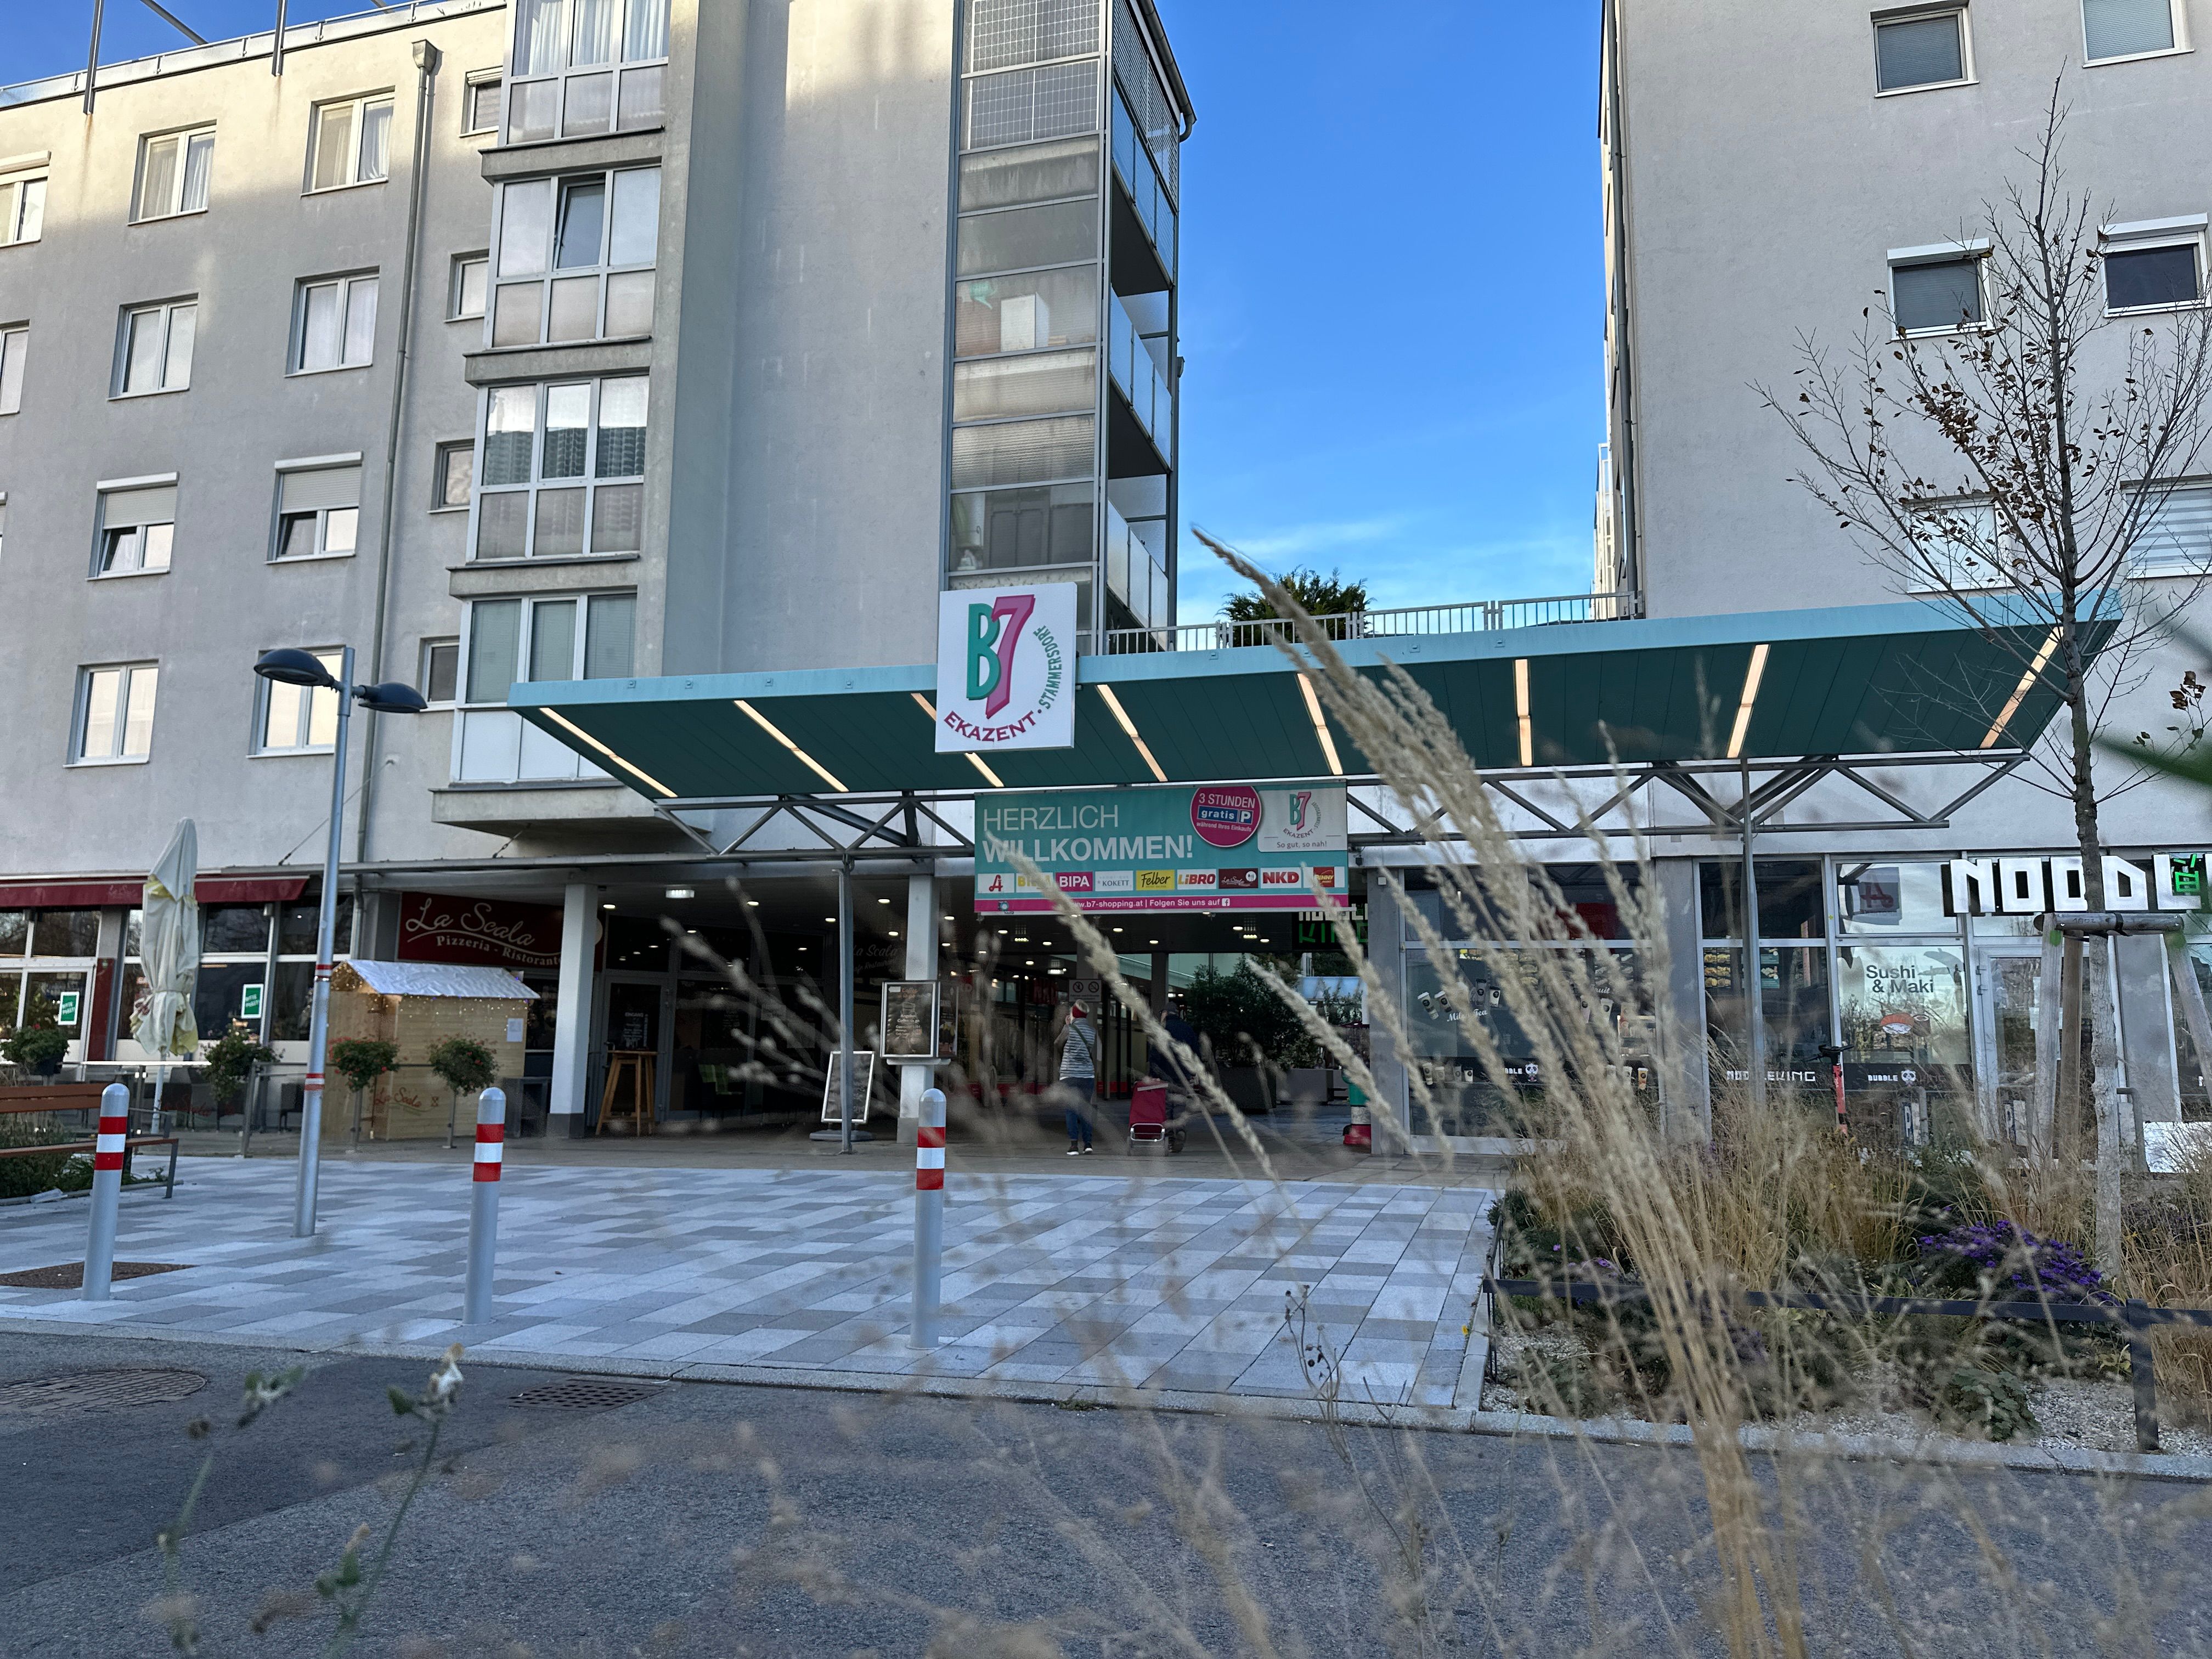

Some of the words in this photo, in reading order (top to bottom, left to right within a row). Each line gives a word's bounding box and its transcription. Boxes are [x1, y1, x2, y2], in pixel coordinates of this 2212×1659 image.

[967, 594, 1035, 719] B7
[1033, 625, 1062, 709] STAMMERSDORF
[944, 710, 1036, 742] EKAZENT
[1199, 793, 1205, 803] 3
[1208, 794, 1255, 808] STUNDEN
[984, 805, 1119, 831] HERZLICH
[1201, 810, 1234, 819] gratis
[1240, 811, 1251, 822] P
[1290, 792, 1311, 831] B7
[1283, 828, 1313, 838] EKAZENT
[1059, 876, 1090, 887] BIPA
[1141, 872, 1170, 888] Felber
[1263, 872, 1299, 883] NKD
[1950, 854, 2212, 913] NOODL
[1150, 899, 1175, 907] Folgen
[405, 898, 454, 932] La
[461, 902, 535, 946] Scala
[436, 935, 490, 952] Pizzeria
[1866, 965, 1915, 978] Sushi
[1872, 979, 1884, 993] &
[1891, 979, 1933, 993] Maki
